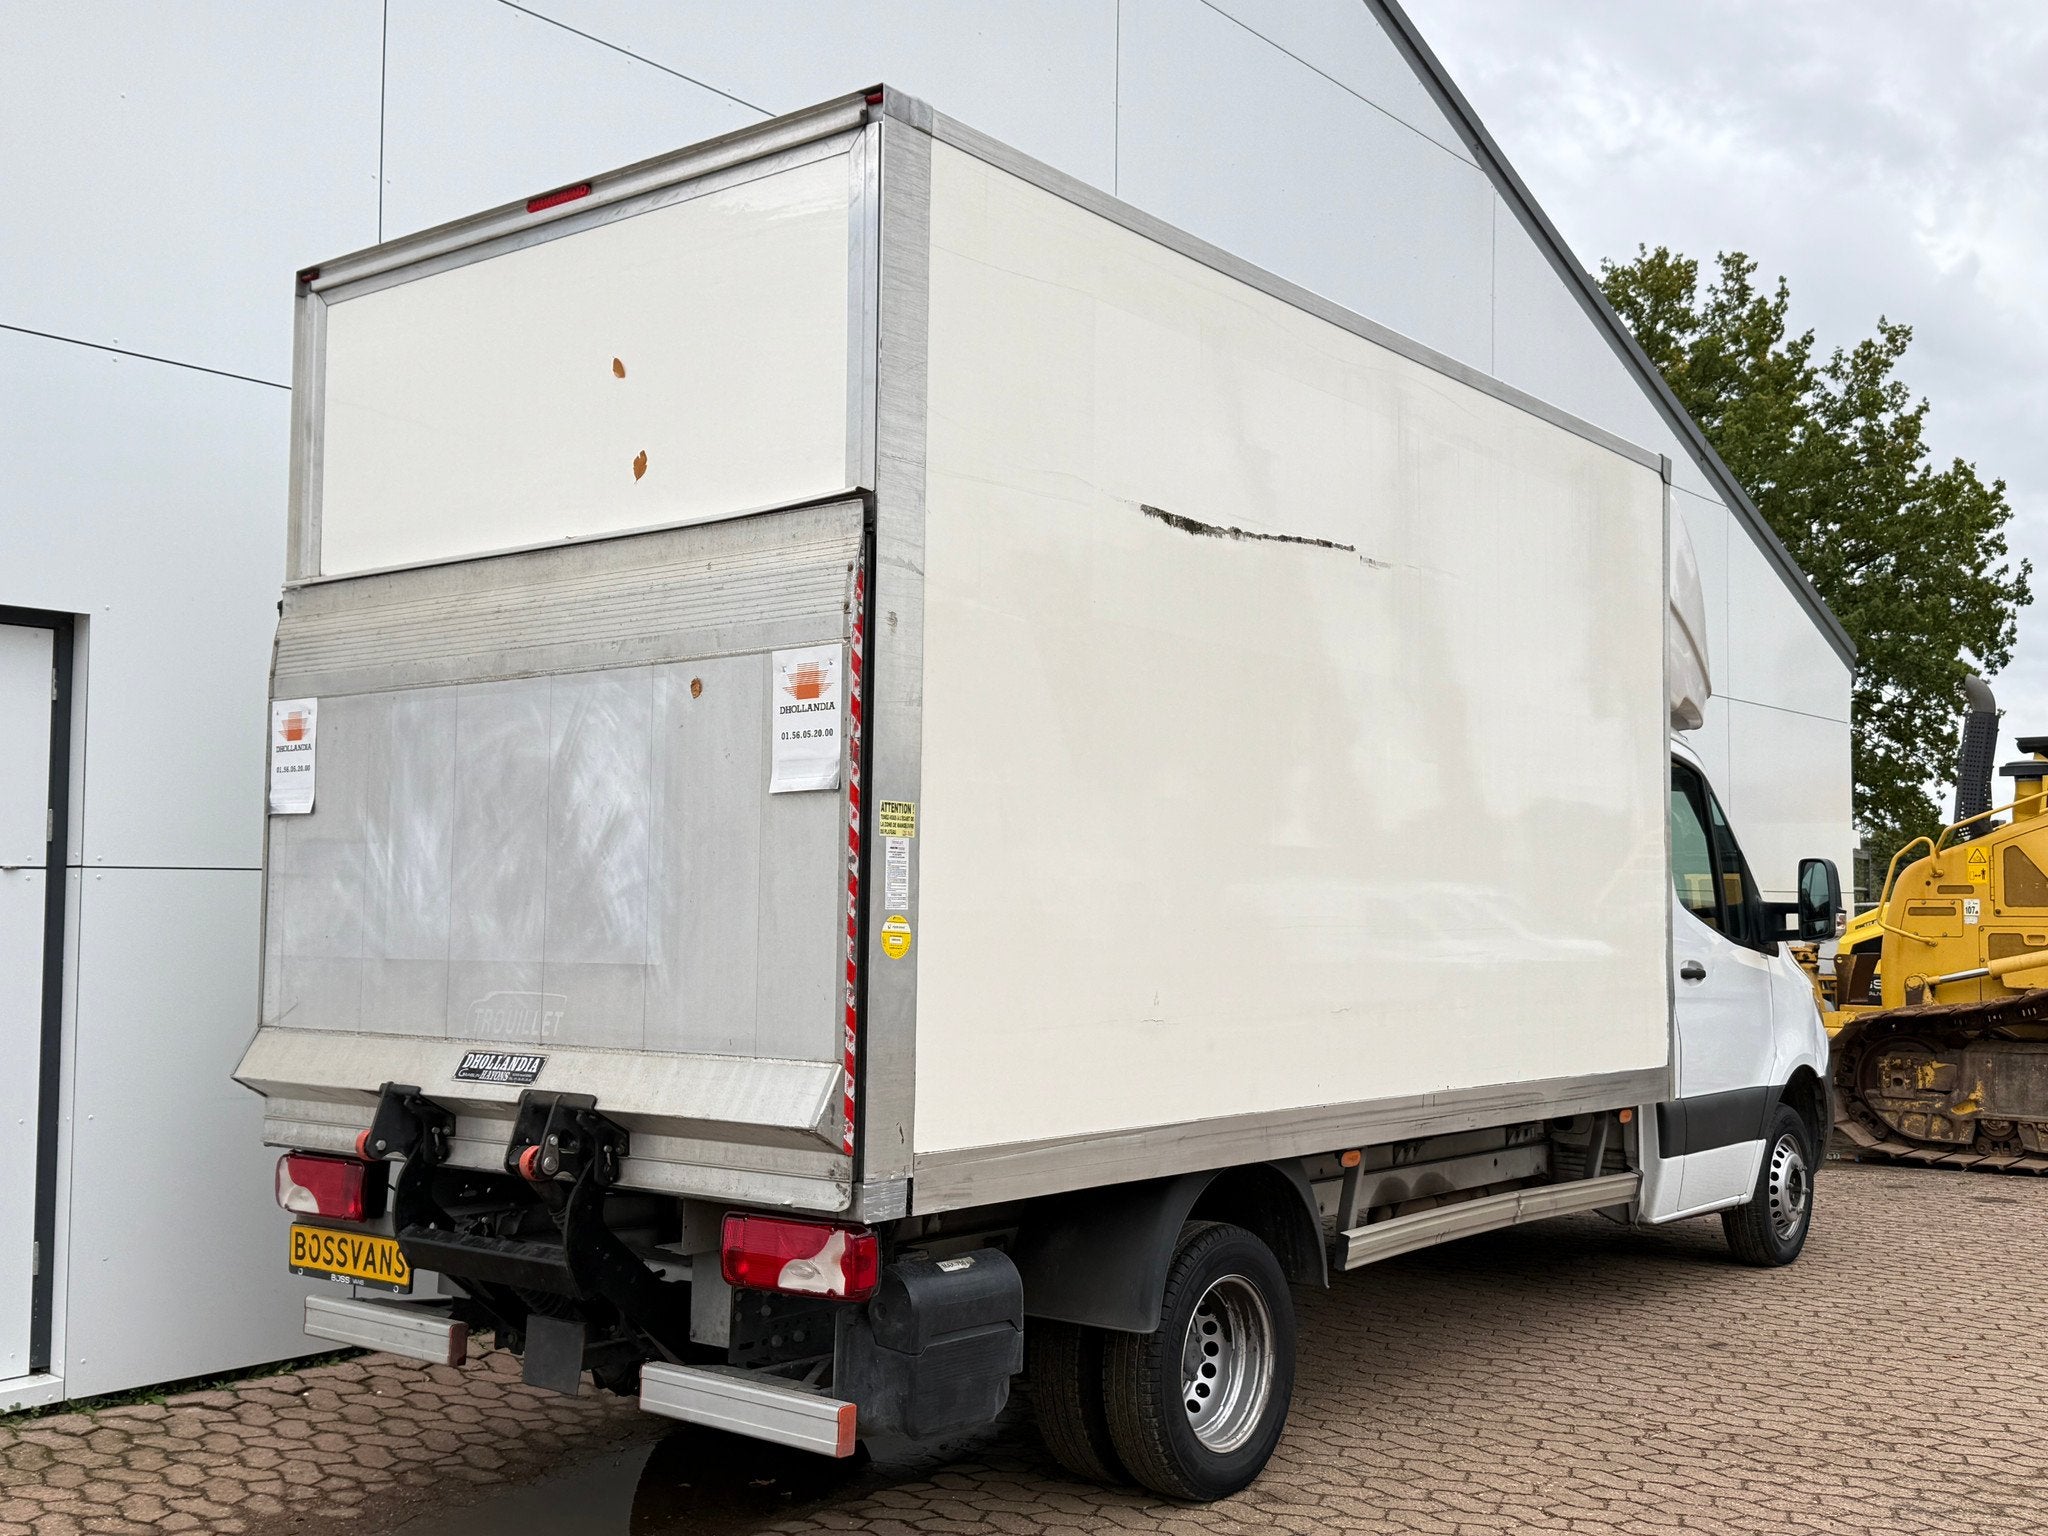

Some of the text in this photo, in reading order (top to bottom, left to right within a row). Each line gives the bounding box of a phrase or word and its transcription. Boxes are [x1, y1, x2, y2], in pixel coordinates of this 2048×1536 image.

[779, 701, 836, 715] DHOLLANDIA
[780, 728, 834, 741] 01.56.05.20.00
[276, 744, 312, 753] DHOLLANDIA
[881, 801, 911, 814] ATTENTION
[1965, 906, 1975, 914] 107
[474, 1008, 564, 1037] TROUILLET
[462, 1054, 540, 1072] DHOLLANDIA
[479, 1069, 510, 1081] HAYONS
[295, 1232, 405, 1278] BOSSVANS
[331, 1274, 350, 1283] BOSS
